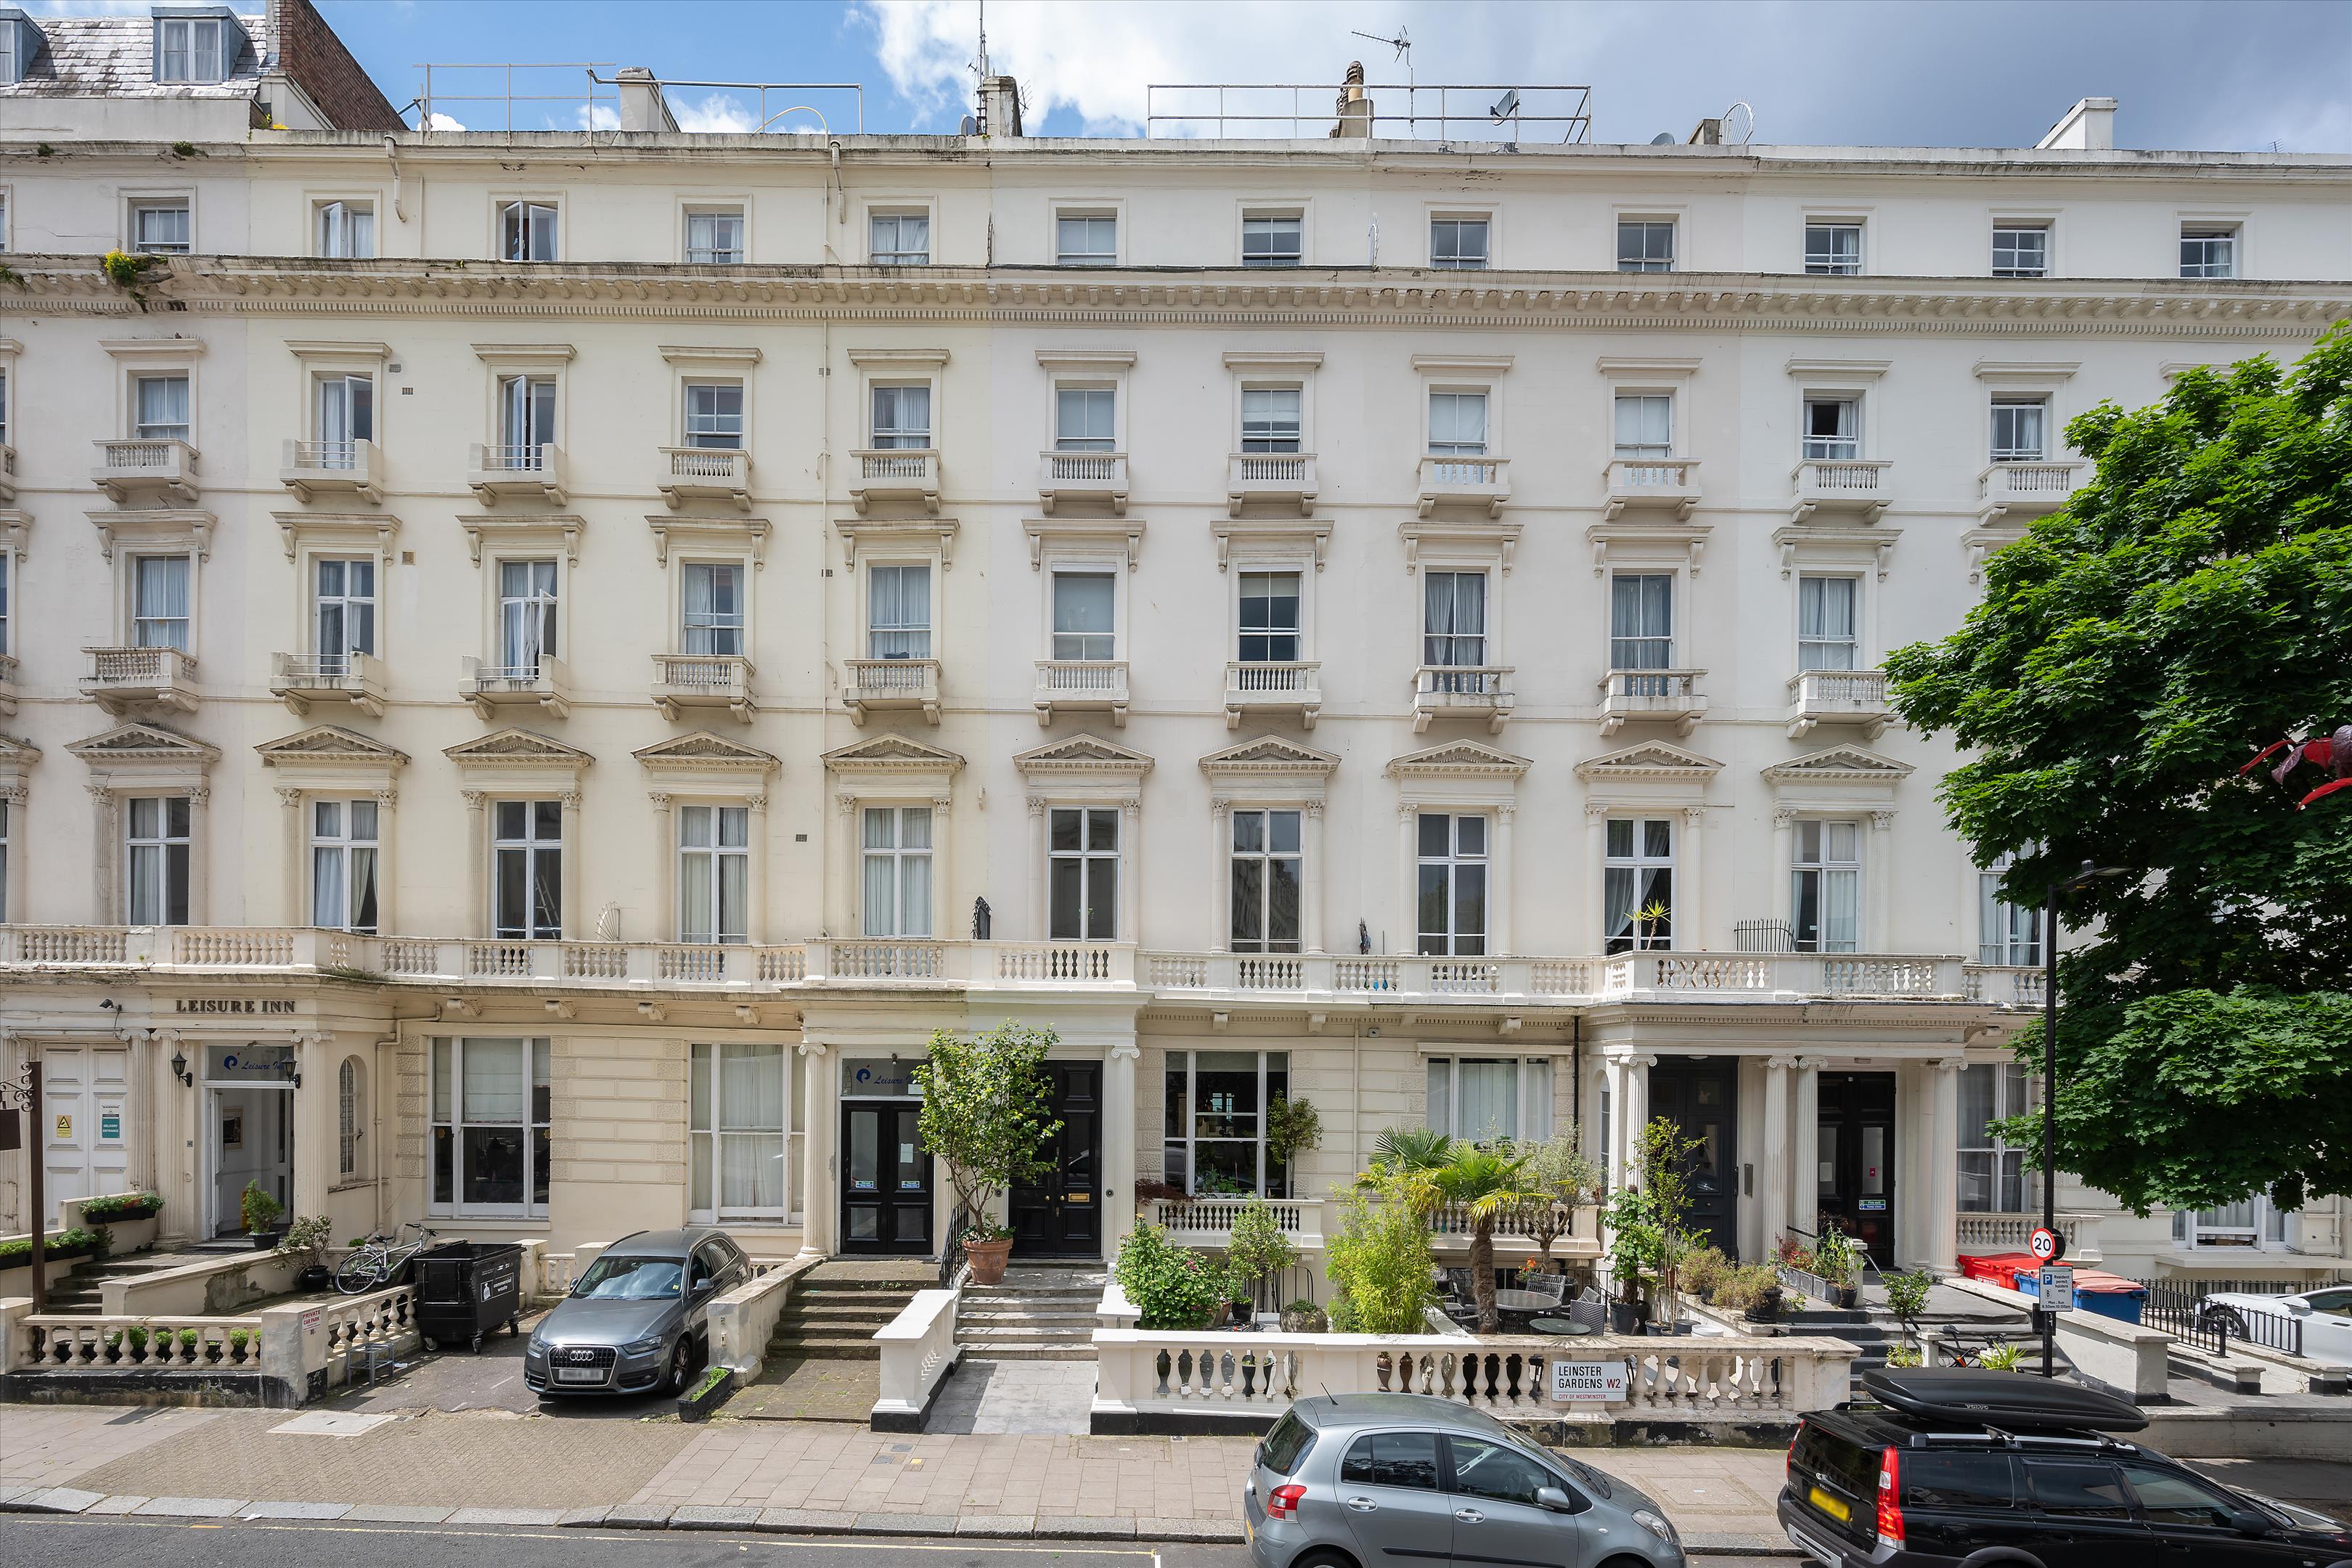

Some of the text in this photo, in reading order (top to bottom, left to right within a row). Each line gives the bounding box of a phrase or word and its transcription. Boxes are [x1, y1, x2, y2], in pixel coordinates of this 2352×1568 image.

[176, 1000, 295, 1013] LEISURE INN
[241, 1061, 270, 1070] Leisure
[873, 1074, 903, 1085] Leisure
[2034, 1237, 2051, 1251] 20
[494, 1277, 512, 1289] commercial
[2044, 1275, 2051, 1284] P
[302, 1310, 321, 1319] PRIVATE
[1559, 1366, 1601, 1376] LEINSTER
[1559, 1379, 1621, 1389] GARDENS W2
